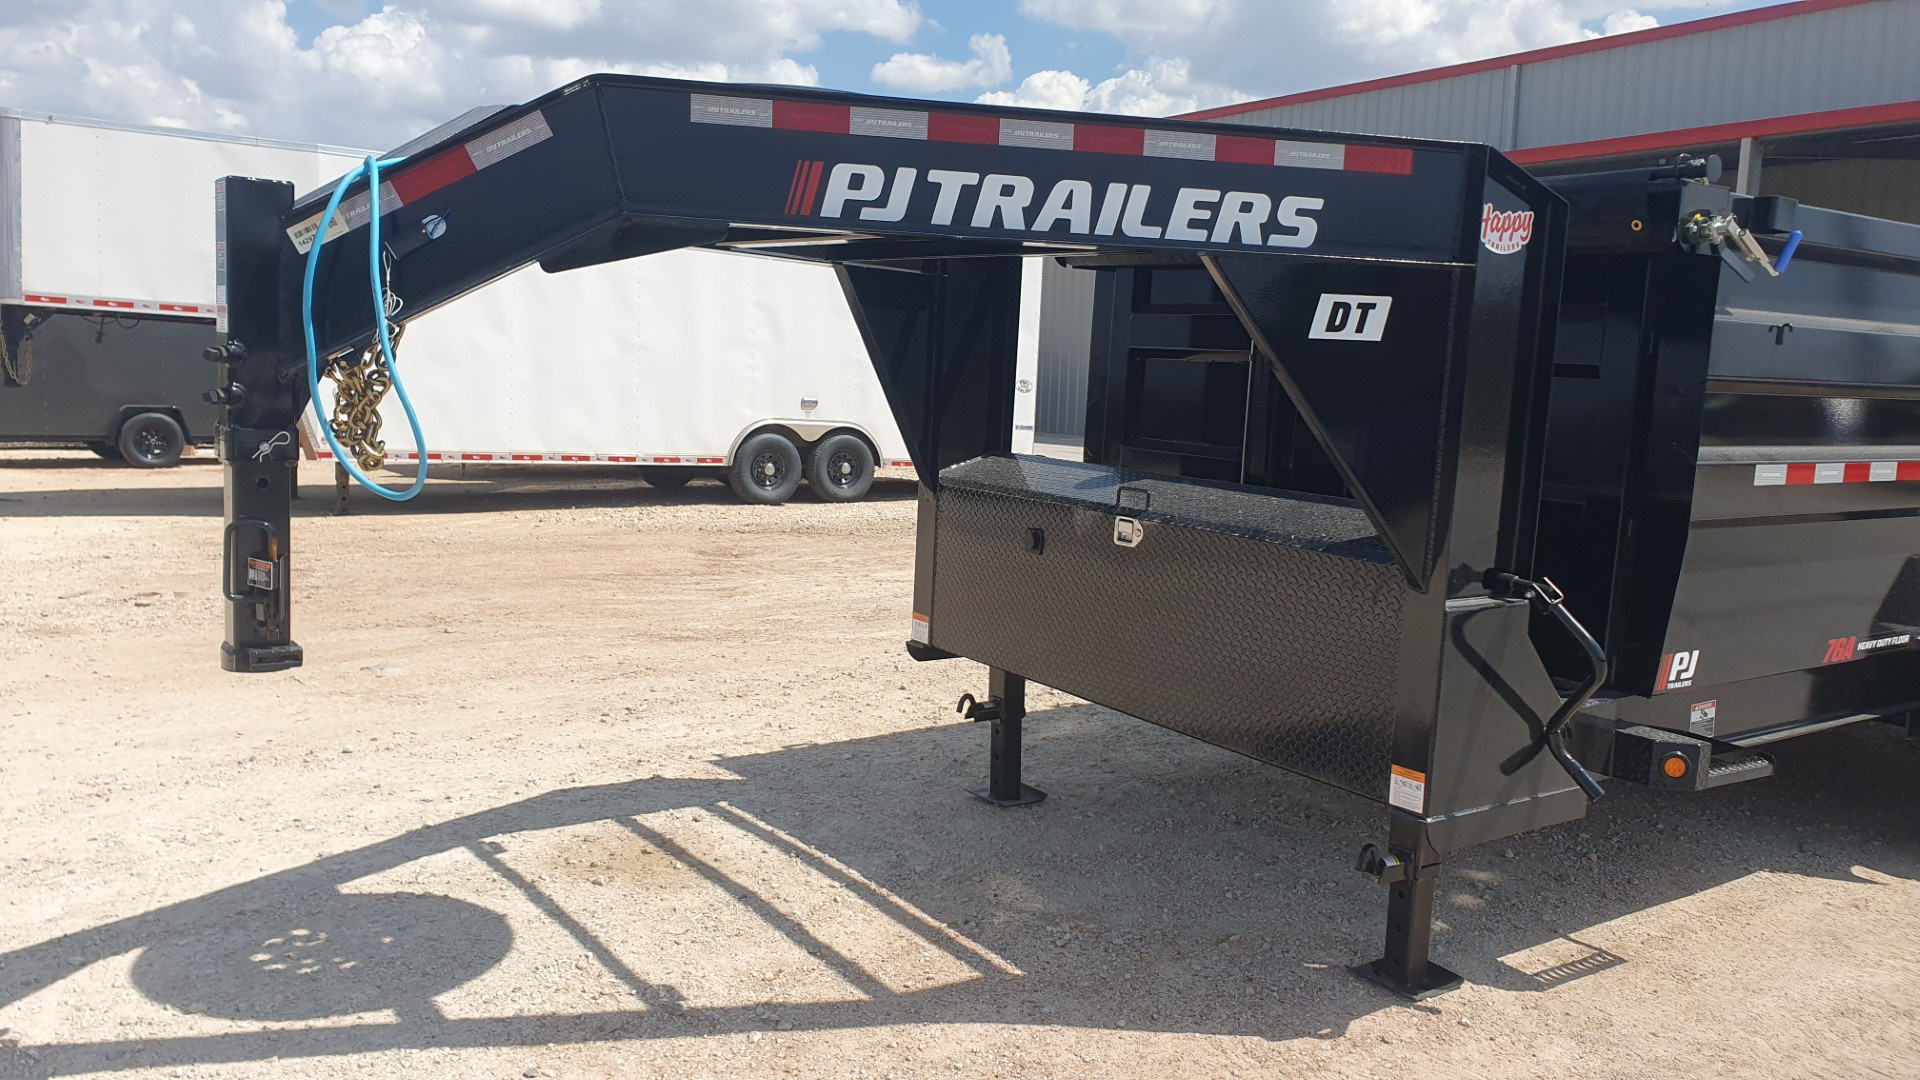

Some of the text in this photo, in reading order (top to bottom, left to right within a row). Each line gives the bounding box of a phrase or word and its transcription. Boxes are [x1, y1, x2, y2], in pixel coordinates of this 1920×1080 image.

[719, 107, 757, 116] TRAILERS
[819, 162, 1325, 249] PJ TRAILERS
[1324, 301, 1378, 334] DT
[1857, 639, 1877, 651] HEAVY
[1876, 636, 1893, 648] DUTY
[1891, 634, 1911, 646] FLOOR
[1668, 649, 1700, 682] PJ
[1666, 679, 1693, 690] TRAILERS
